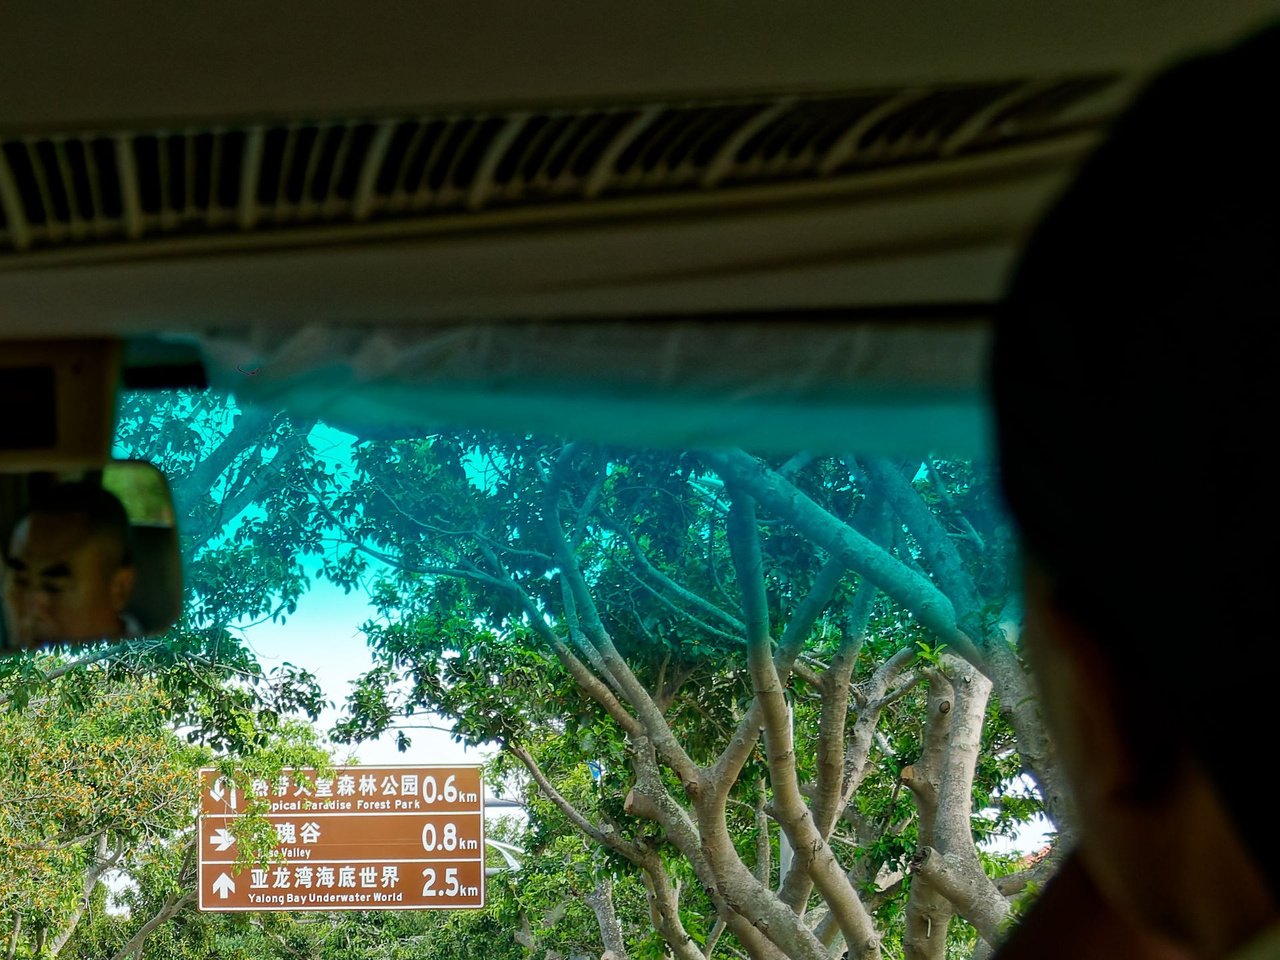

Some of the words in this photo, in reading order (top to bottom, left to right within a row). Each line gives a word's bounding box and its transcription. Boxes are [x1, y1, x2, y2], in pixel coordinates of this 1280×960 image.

[305, 800, 351, 810] Paradise
[357, 800, 390, 810] Forest
[395, 799, 420, 809] Park
[281, 848, 311, 859] Valley
[250, 866, 399, 889] 亚龙湾海底世界
[248, 893, 284, 905] Yalong
[287, 893, 307, 905] Bay
[309, 892, 370, 903] Underwater
[373, 892, 403, 902] World
